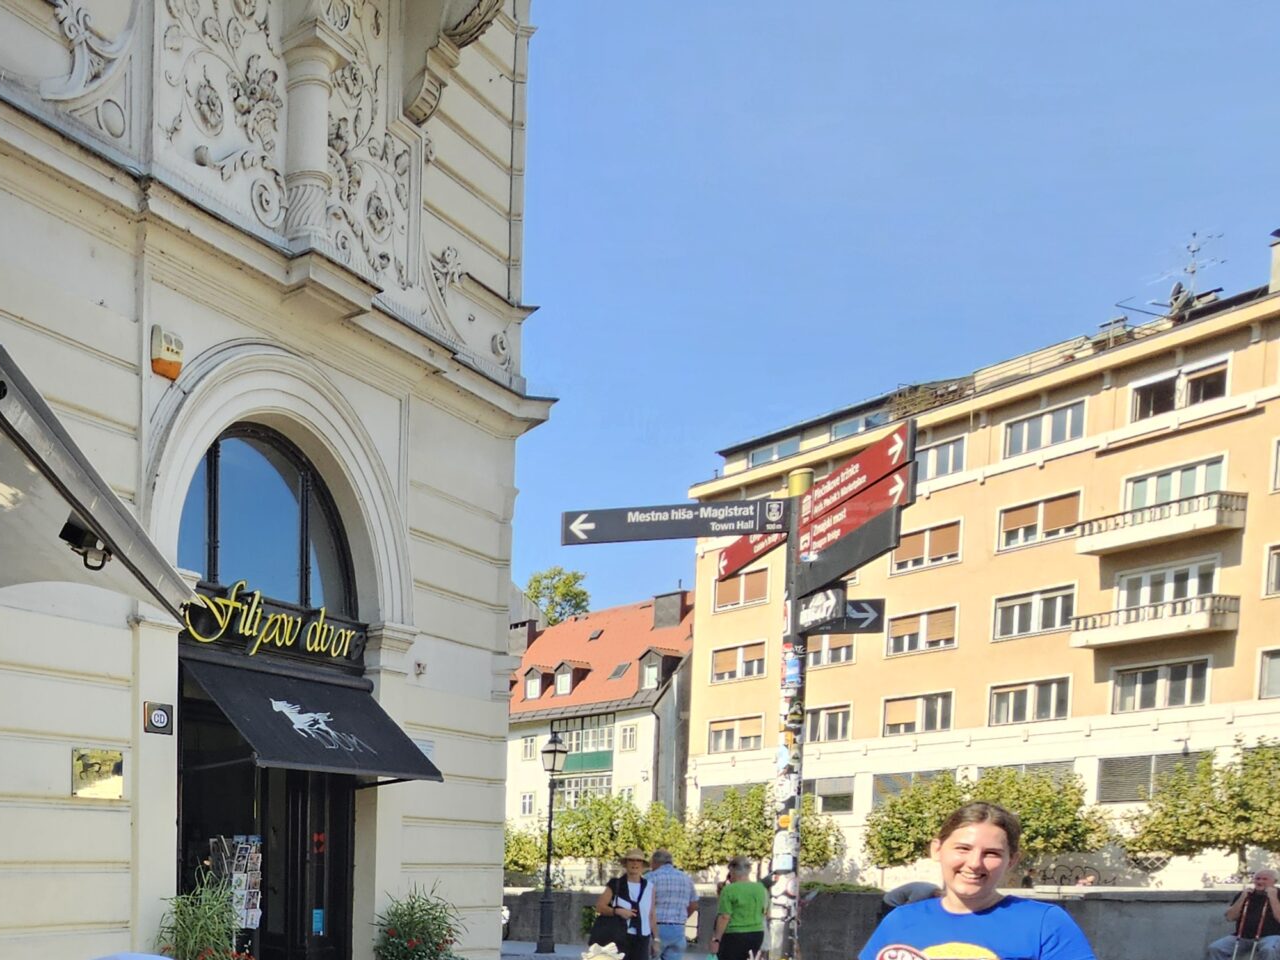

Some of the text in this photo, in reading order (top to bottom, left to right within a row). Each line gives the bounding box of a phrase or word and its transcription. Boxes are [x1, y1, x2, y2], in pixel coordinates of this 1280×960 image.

[627, 511, 669, 523] Mestna
[710, 519, 754, 531] Town Hall
[307, 606, 356, 658] dvor
[153, 712, 166, 724] CD
